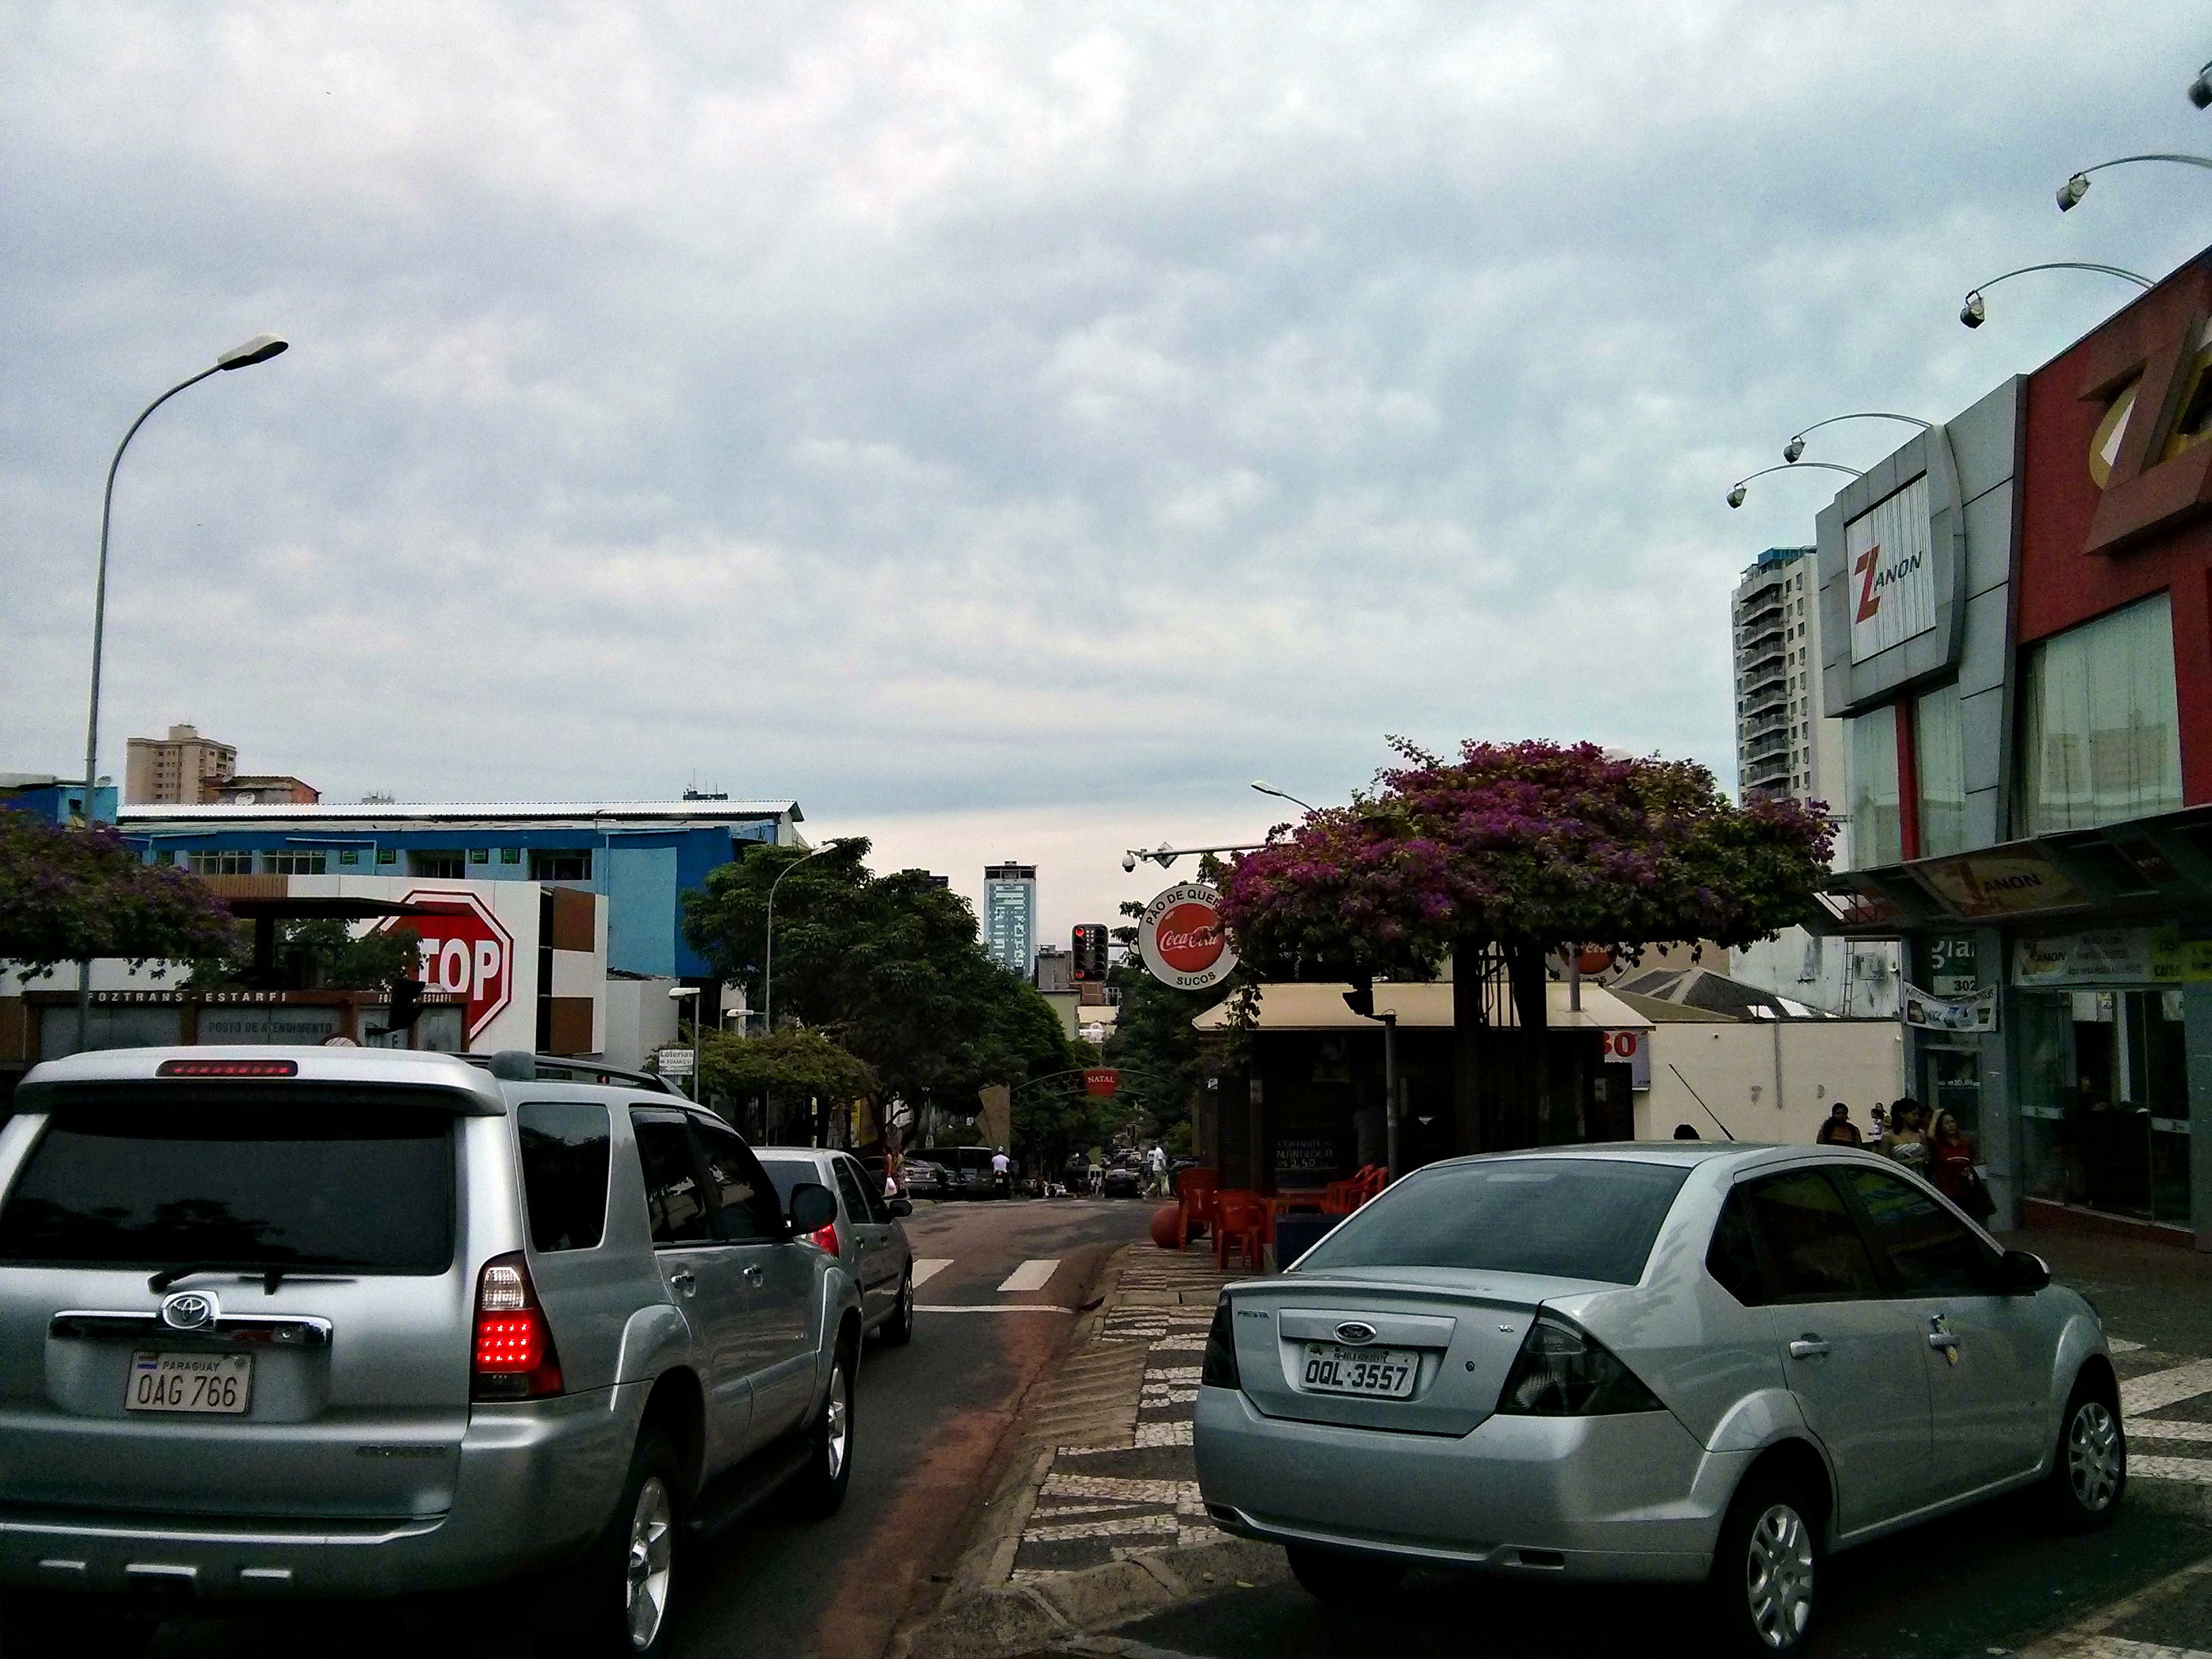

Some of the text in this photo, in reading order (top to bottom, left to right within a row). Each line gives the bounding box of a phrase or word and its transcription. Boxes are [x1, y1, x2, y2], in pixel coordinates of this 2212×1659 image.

[1853, 544, 1922, 624] ZANON
[1145, 901, 1166, 926] PÃO
[1166, 890, 1184, 903] DE
[416, 938, 501, 1001] TOP
[1176, 971, 1216, 986] SUCOS
[87, 991, 184, 1002] FOZTRANS
[205, 991, 287, 1002] ESTARFI
[208, 1022, 333, 1034] POSTO DE ATENDIMENTO
[1087, 1075, 1115, 1084] NATAL
[162, 1361, 220, 1371] PARAGUAY
[190, 1376, 237, 1406] 766
